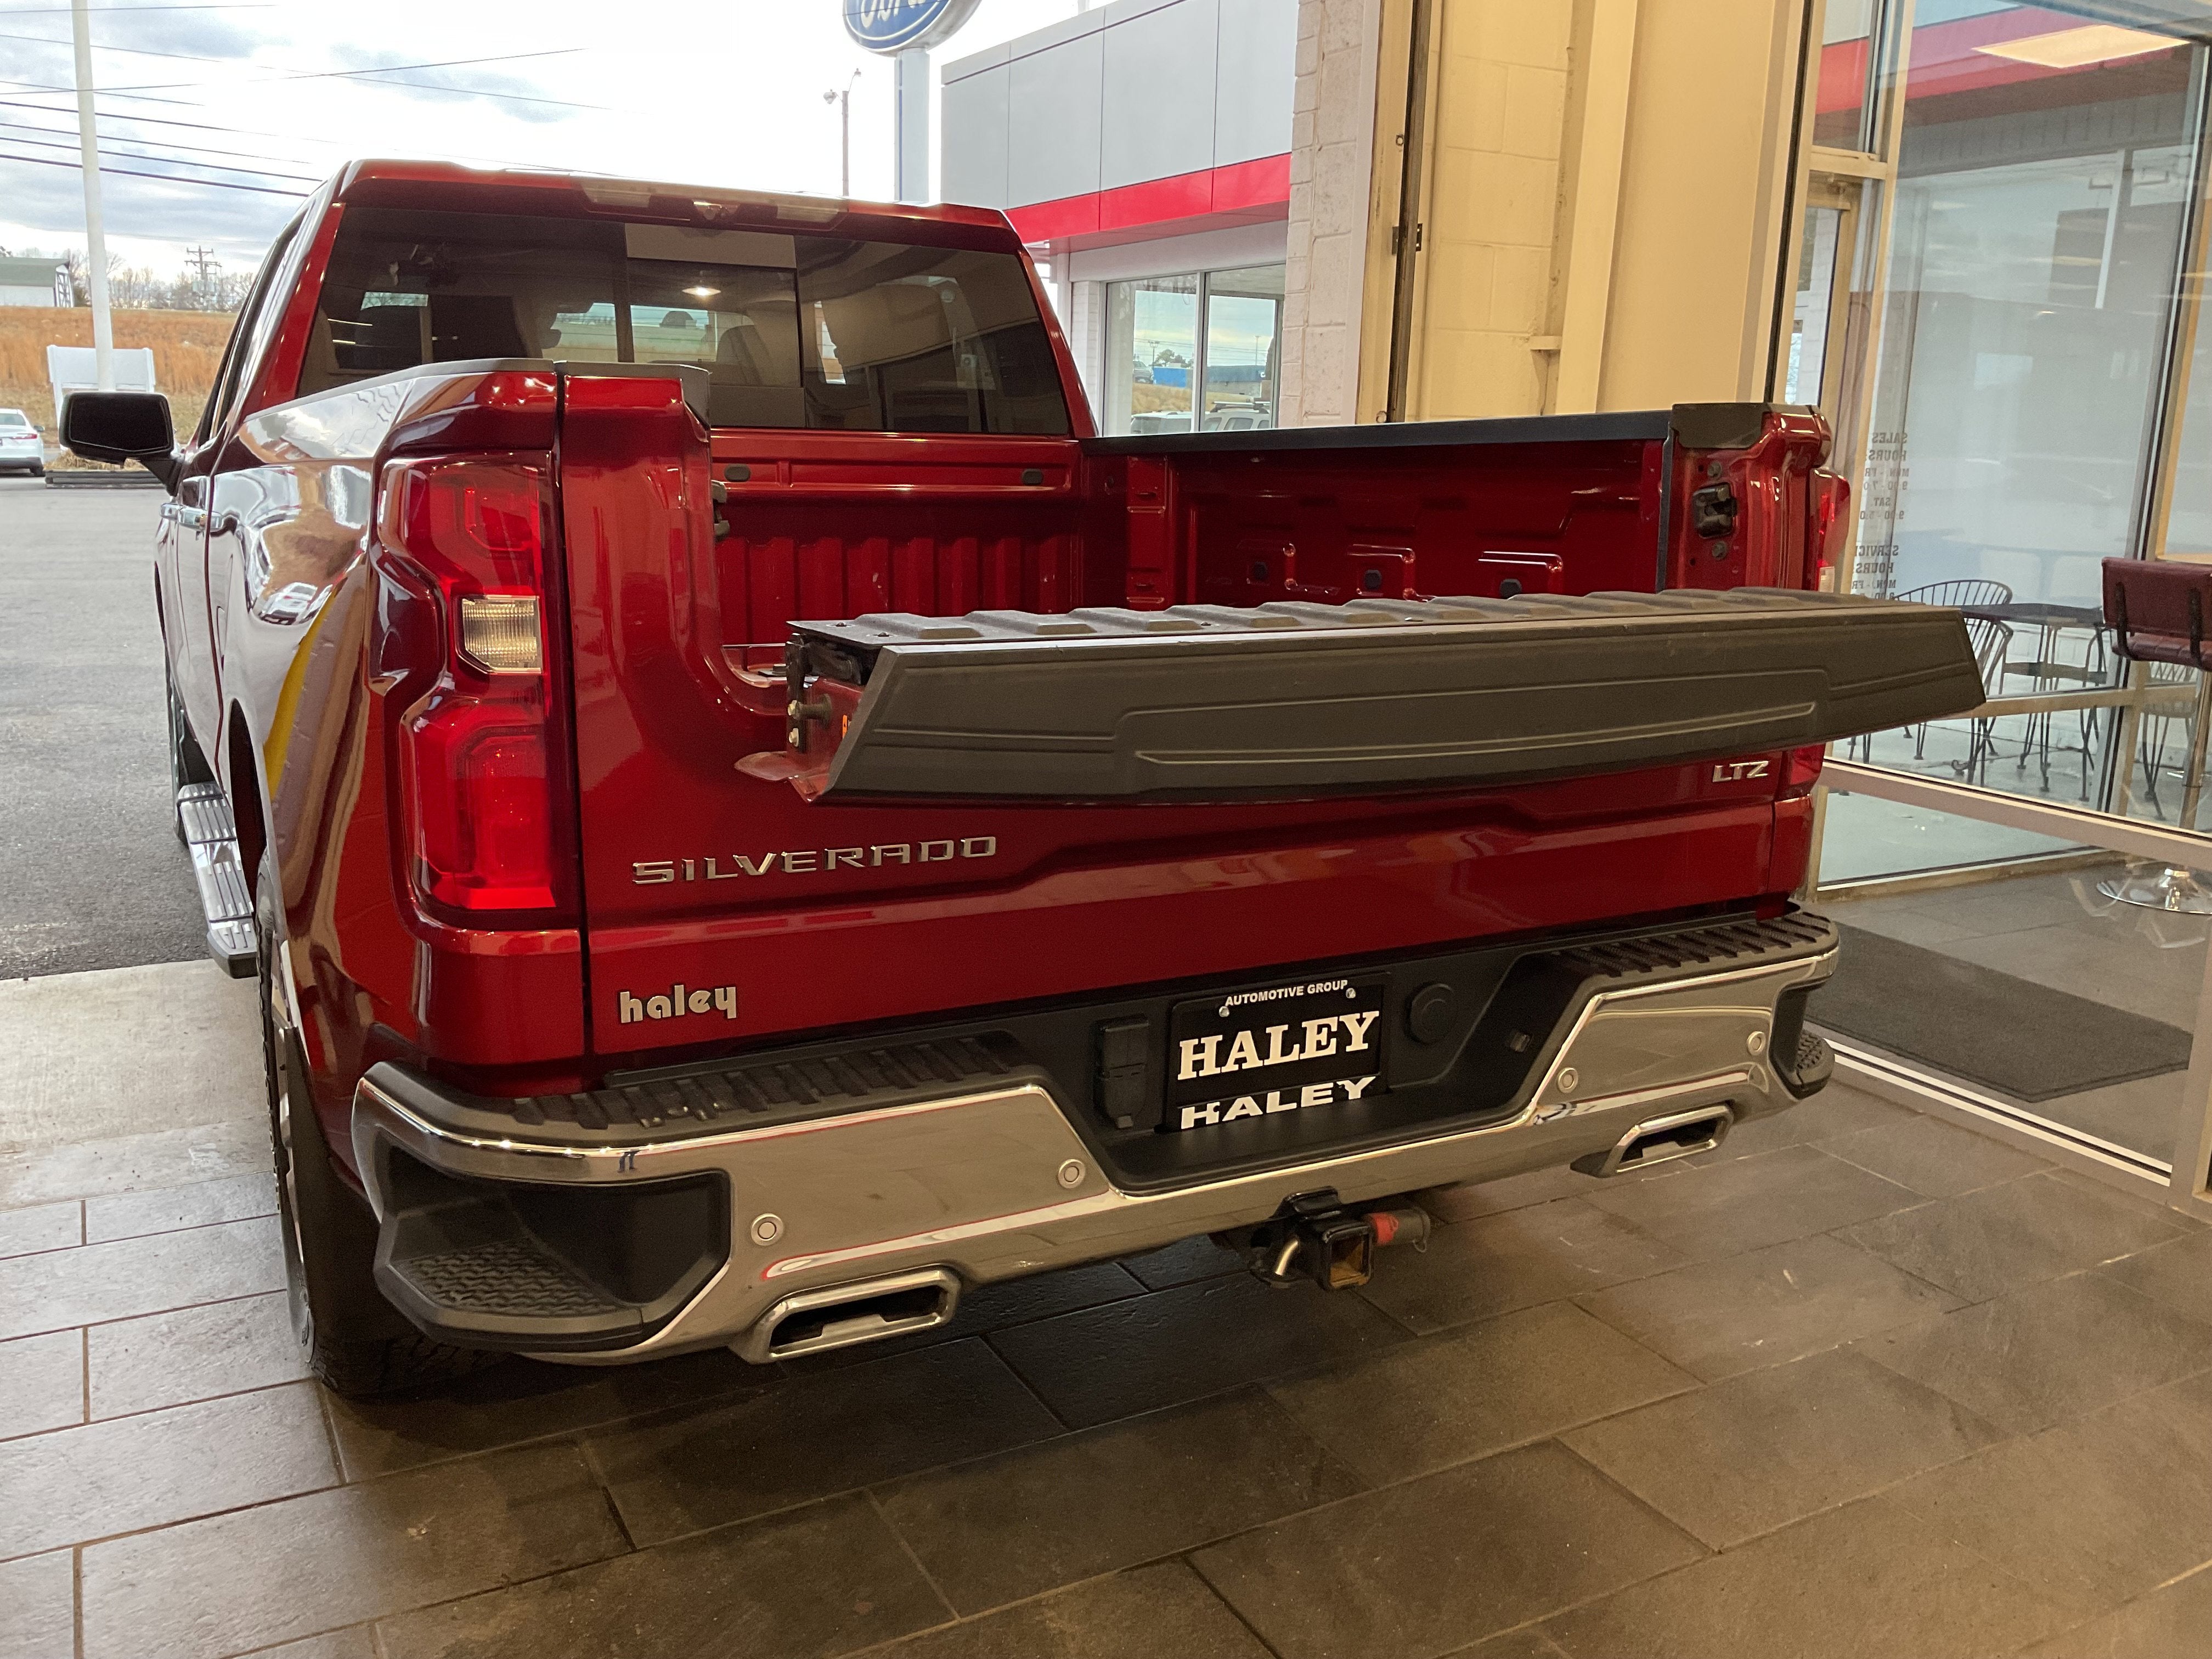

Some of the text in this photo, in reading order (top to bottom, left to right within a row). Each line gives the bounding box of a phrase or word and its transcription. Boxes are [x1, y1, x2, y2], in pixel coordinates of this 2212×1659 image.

[1712, 760, 1769, 782] LTZ
[632, 836, 996, 884] SILVERADO
[620, 984, 737, 1024] haley
[1224, 979, 1348, 1007] AUTOMOTIVE GROUP
[1177, 1011, 1380, 1080] HALEY
[1181, 1076, 1376, 1130] HALEY
